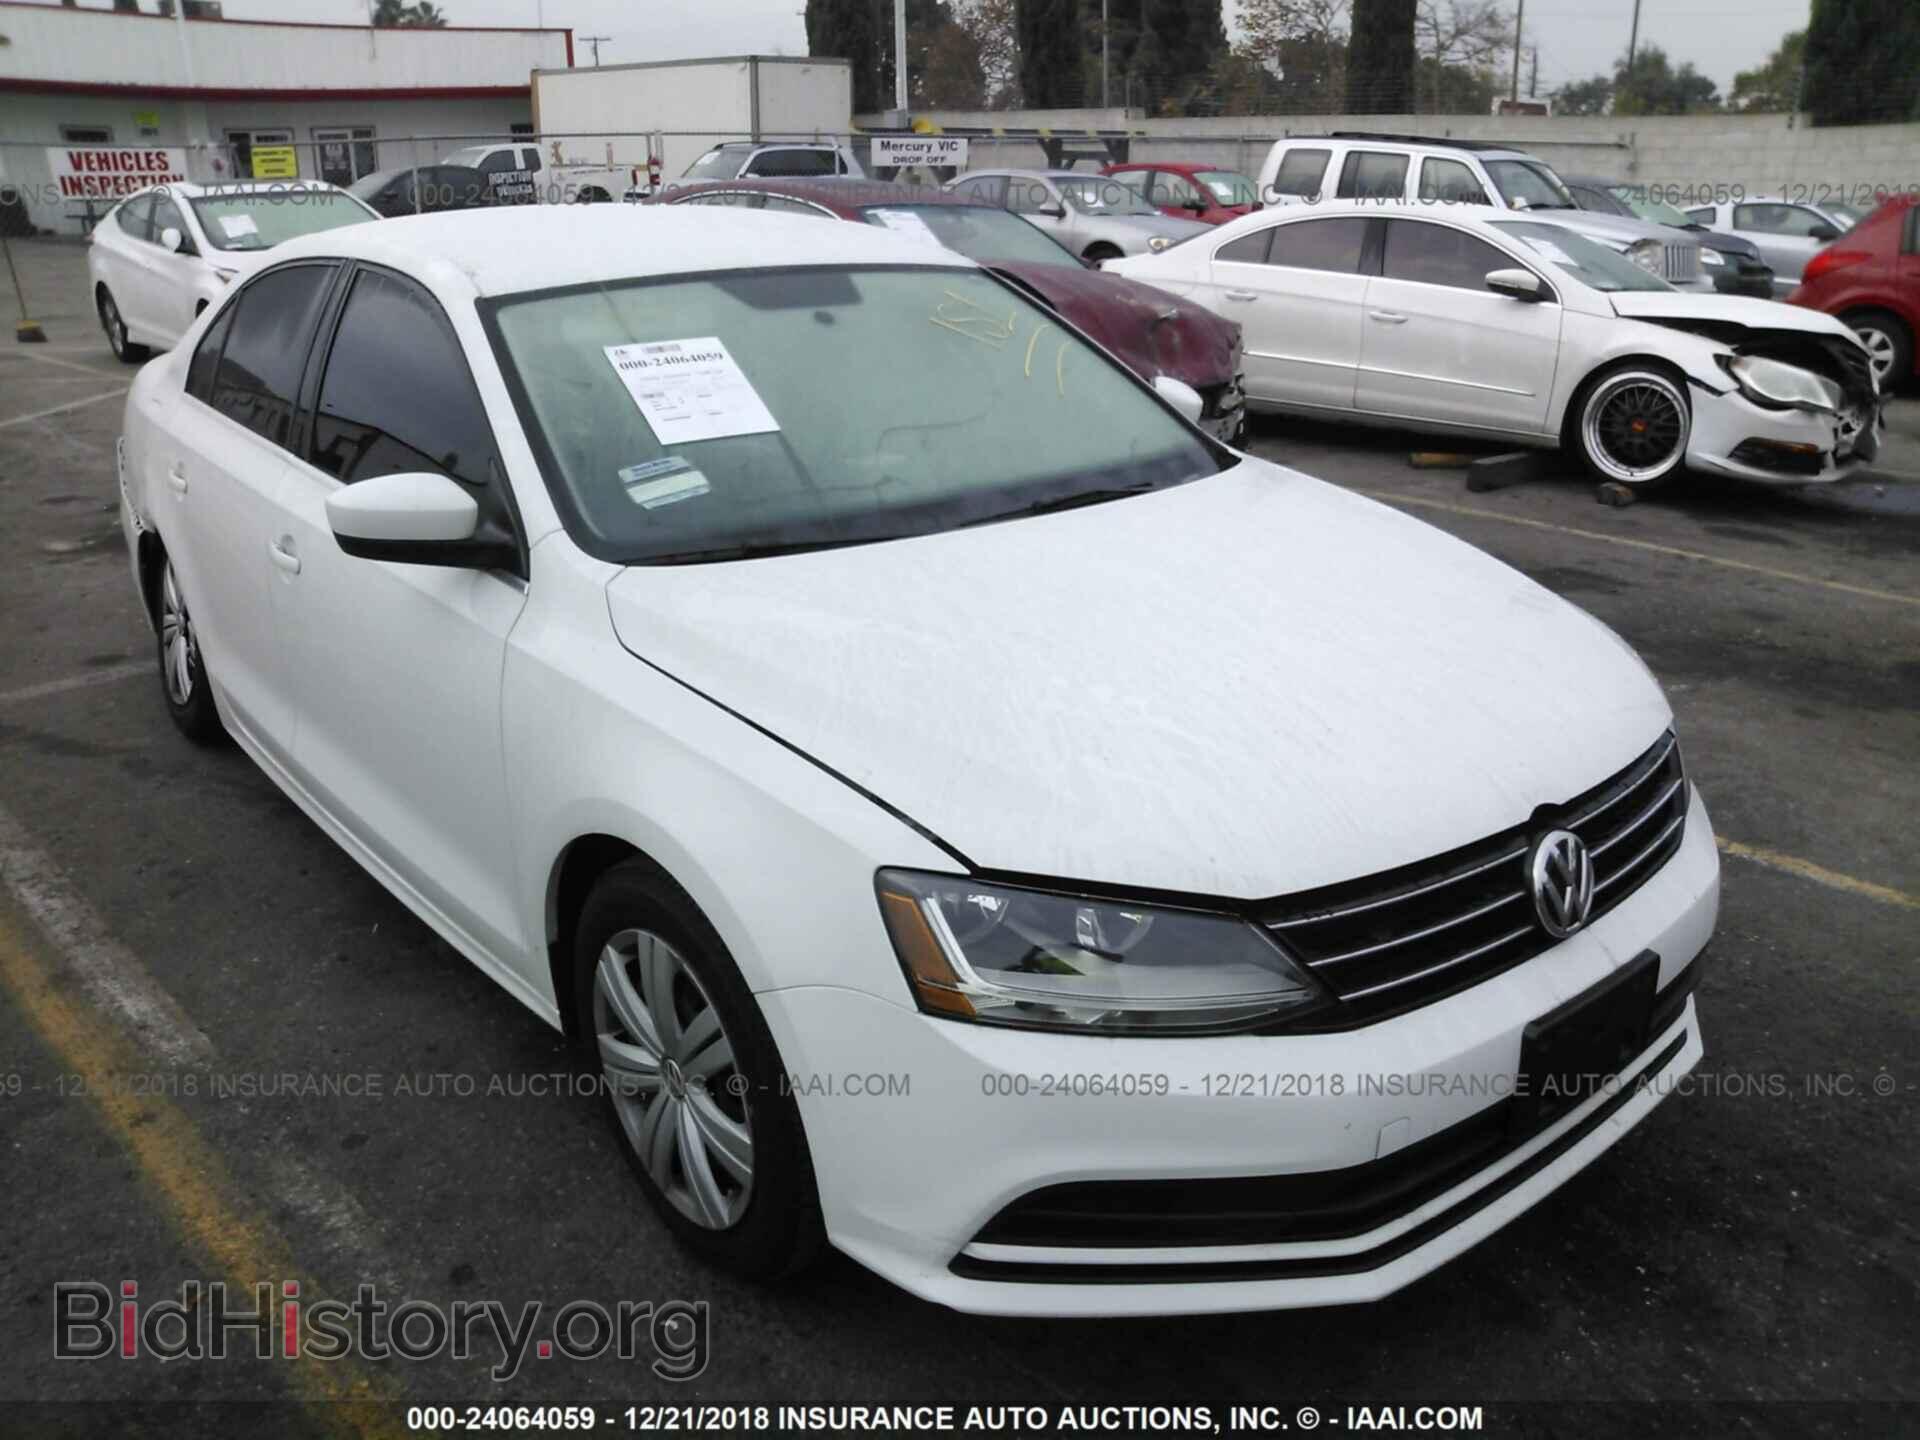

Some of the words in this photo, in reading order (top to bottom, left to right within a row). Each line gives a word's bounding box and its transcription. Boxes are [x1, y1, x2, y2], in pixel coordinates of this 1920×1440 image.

[881, 140, 933, 154] Mercury
[938, 141, 959, 151] VIC
[67, 151, 169, 172] VEHICLES
[893, 156, 922, 164] DROP
[927, 156, 947, 164] OFF
[619, 351, 724, 371] 000-24064059
